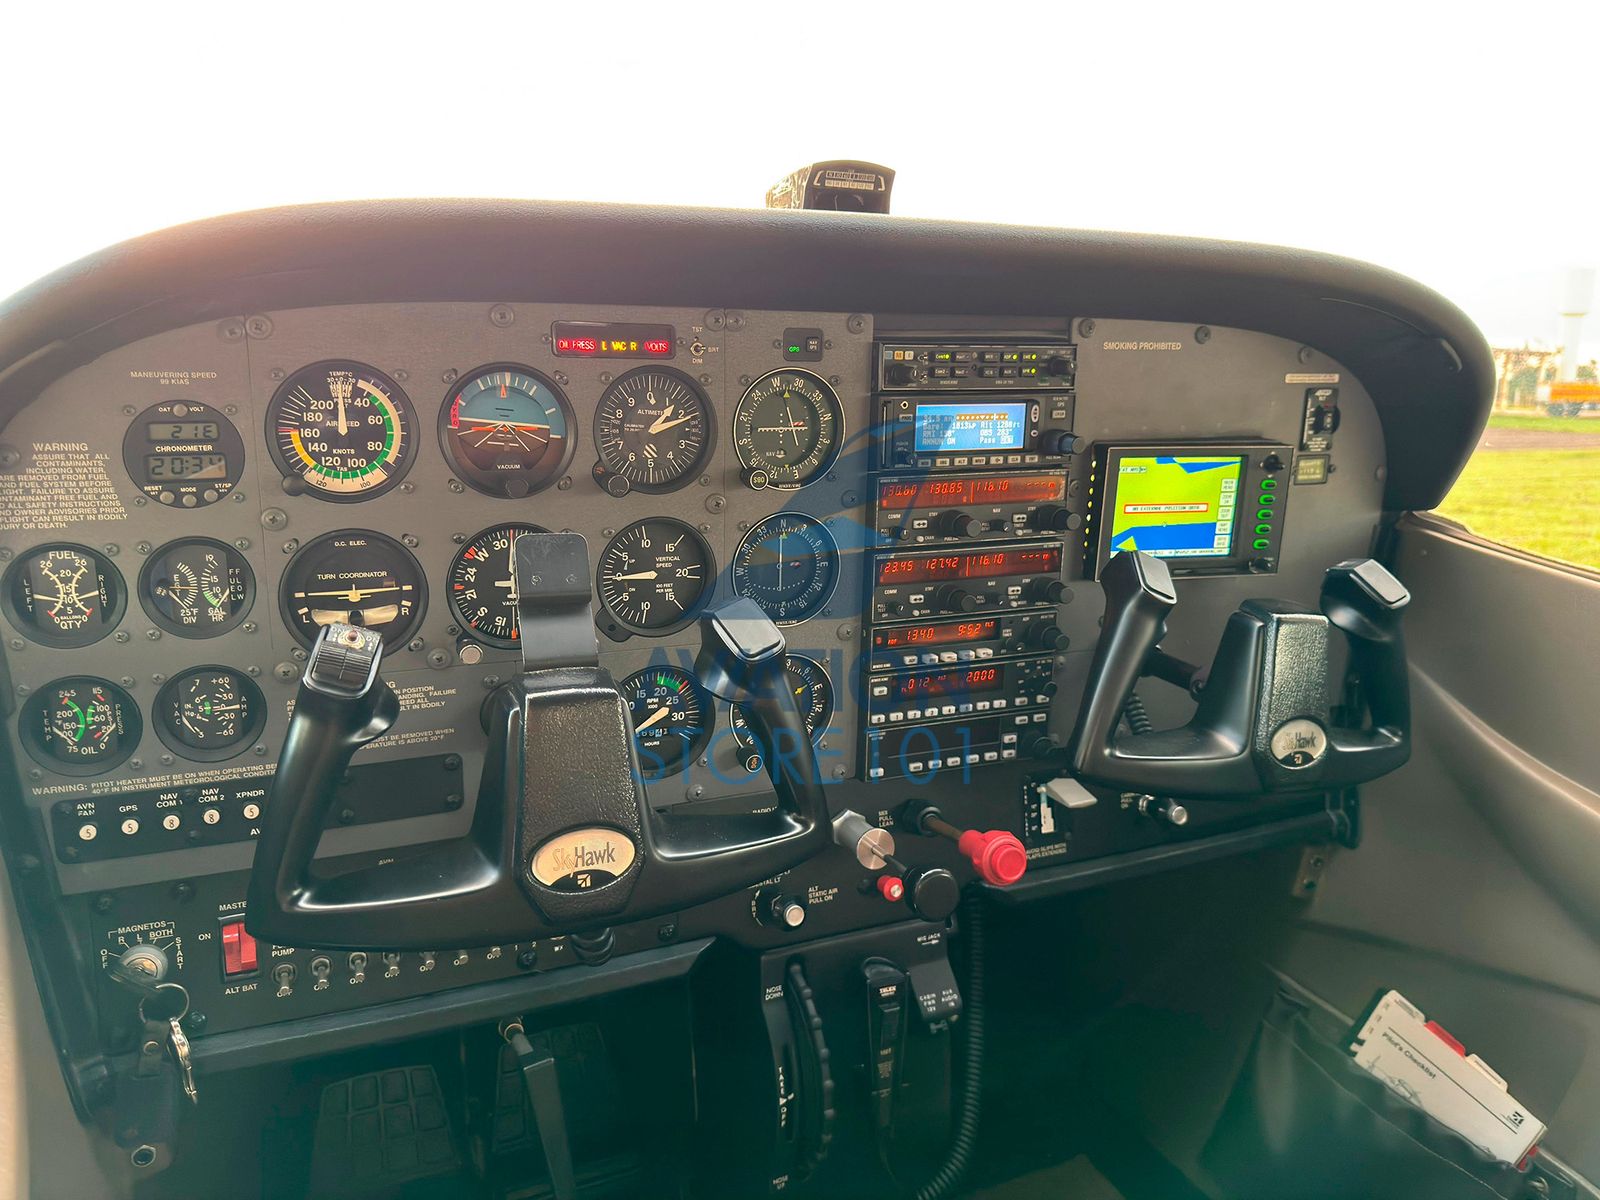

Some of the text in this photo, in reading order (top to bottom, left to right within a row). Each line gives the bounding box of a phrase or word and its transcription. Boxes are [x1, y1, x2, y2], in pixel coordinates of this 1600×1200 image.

[573, 341, 595, 350] PRESS
[647, 342, 667, 351] VOLTS
[1103, 341, 1182, 350] SMOKING PROHIBITED
[771, 377, 780, 388] W
[793, 378, 804, 388] 30
[310, 400, 334, 410] 200
[354, 398, 370, 408] 40
[628, 397, 635, 406] 9
[303, 412, 323, 422] 180
[616, 409, 623, 419] 8
[326, 420, 360, 428] AIREED
[367, 415, 383, 425] 60
[300, 428, 320, 438] 160
[32, 442, 88, 452] WARNING
[308, 442, 328, 452] 140
[367, 441, 383, 451] 80
[679, 440, 686, 449] 3
[32, 453, 65, 461] ASSURE
[629, 452, 636, 461] 6
[667, 451, 673, 459] 4
[322, 456, 341, 466] 120
[347, 458, 367, 468] 100
[647, 459, 654, 468] 5
[26, 467, 73, 475] INCLUDING
[18, 474, 60, 482] REMOVED
[26, 501, 57, 509] SAFETY
[48, 507, 98, 515] ADVISORIES
[492, 538, 509, 551] 30
[641, 539, 651, 549] 10
[665, 543, 675, 553] 15
[48, 550, 79, 560] FUEL
[474, 548, 490, 563] W
[39, 560, 53, 568] 26
[74, 558, 88, 567] 26
[60, 569, 71, 578] 20
[339, 571, 388, 579] COORDINATOR
[464, 566, 478, 583] 24
[676, 568, 689, 577] 20
[23, 578, 33, 613] LEFT
[98, 574, 108, 608] RIGHT
[465, 588, 478, 601] 21
[665, 592, 675, 601] 15
[641, 601, 651, 610] 10
[208, 607, 227, 616] GAL
[401, 607, 409, 616] R
[477, 606, 488, 617] S
[60, 620, 82, 630] QTY
[183, 616, 198, 624] DIV
[494, 615, 507, 627] 15
[907, 623, 981, 641] 1340 9:52
[211, 676, 230, 684] +60
[966, 668, 996, 682] 2000
[59, 689, 77, 698] 245
[402, 686, 434, 694] POSITION
[429, 688, 456, 697] FAILURE
[636, 689, 647, 699] 15
[653, 686, 668, 697] 20
[421, 701, 446, 709] BODILY
[665, 695, 679, 706] 25
[96, 704, 110, 712] 100
[56, 710, 74, 719] 200
[671, 711, 685, 721] 30
[43, 709, 52, 741] TEMP
[63, 721, 77, 730] 150
[401, 730, 434, 739] REMOVED
[407, 736, 430, 744] ABOVE
[81, 746, 98, 756] OIL
[32, 764, 264, 795] WARNING: PITOT HEATER MUST WHEN OPERATING
[122, 773, 241, 792] INSTRUMENT METEOROLOGICAL
[160, 793, 178, 801] NAV
[202, 788, 220, 796] NAV
[235, 789, 265, 798] XPNDR
[156, 800, 177, 808] COM
[198, 795, 218, 803] COM
[119, 804, 138, 812] GPS
[552, 841, 616, 878] SkyHawk
[219, 900, 247, 911] MASTE
[117, 920, 167, 934] MAGNETOS
[148, 928, 174, 938] BOTH
[198, 933, 211, 941] ON
[175, 936, 184, 970] START
[271, 947, 295, 957] PUMP
[225, 983, 258, 995] ALT BAT
